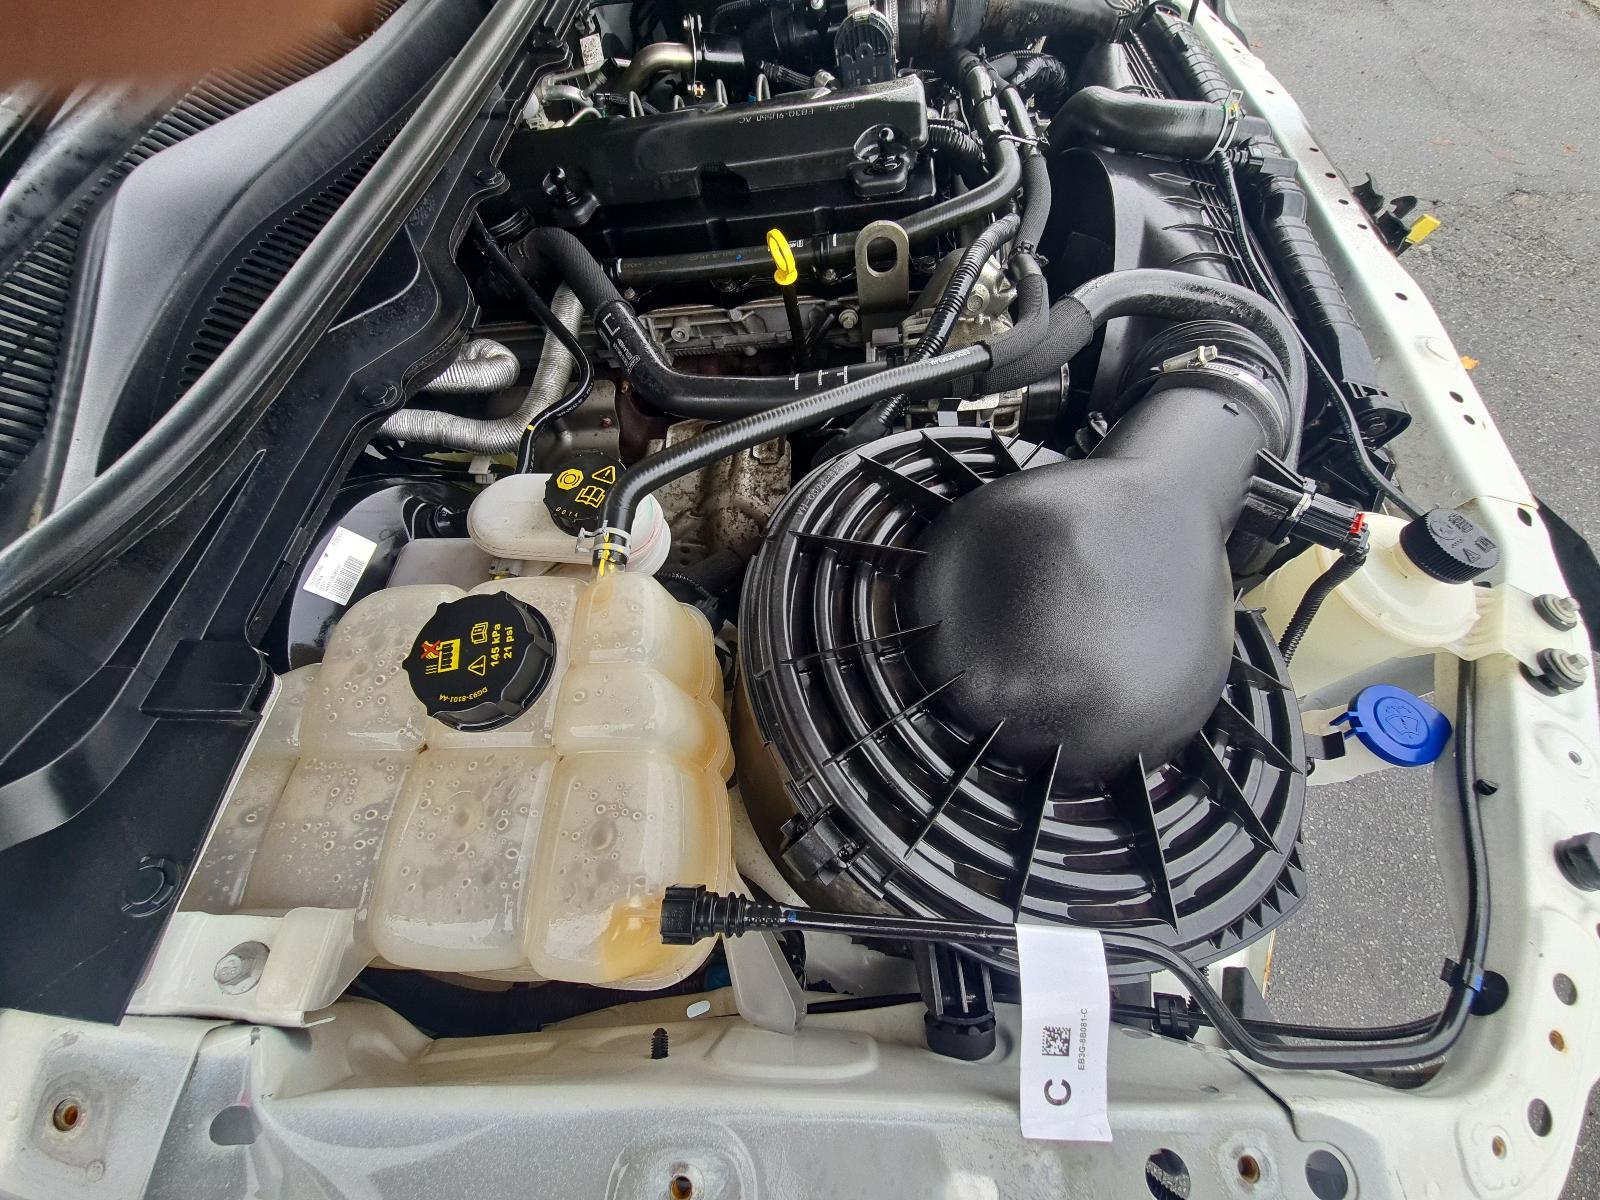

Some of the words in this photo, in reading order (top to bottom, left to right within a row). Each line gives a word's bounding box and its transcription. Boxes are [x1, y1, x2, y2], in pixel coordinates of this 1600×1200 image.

[491, 623, 501, 644] kPa
[504, 626, 515, 643] psi
[490, 647, 500, 667] 145
[503, 646, 513, 659] 21
[1077, 1008, 1088, 1071] EB3G-8B081-C
[1043, 1079, 1072, 1106] C
